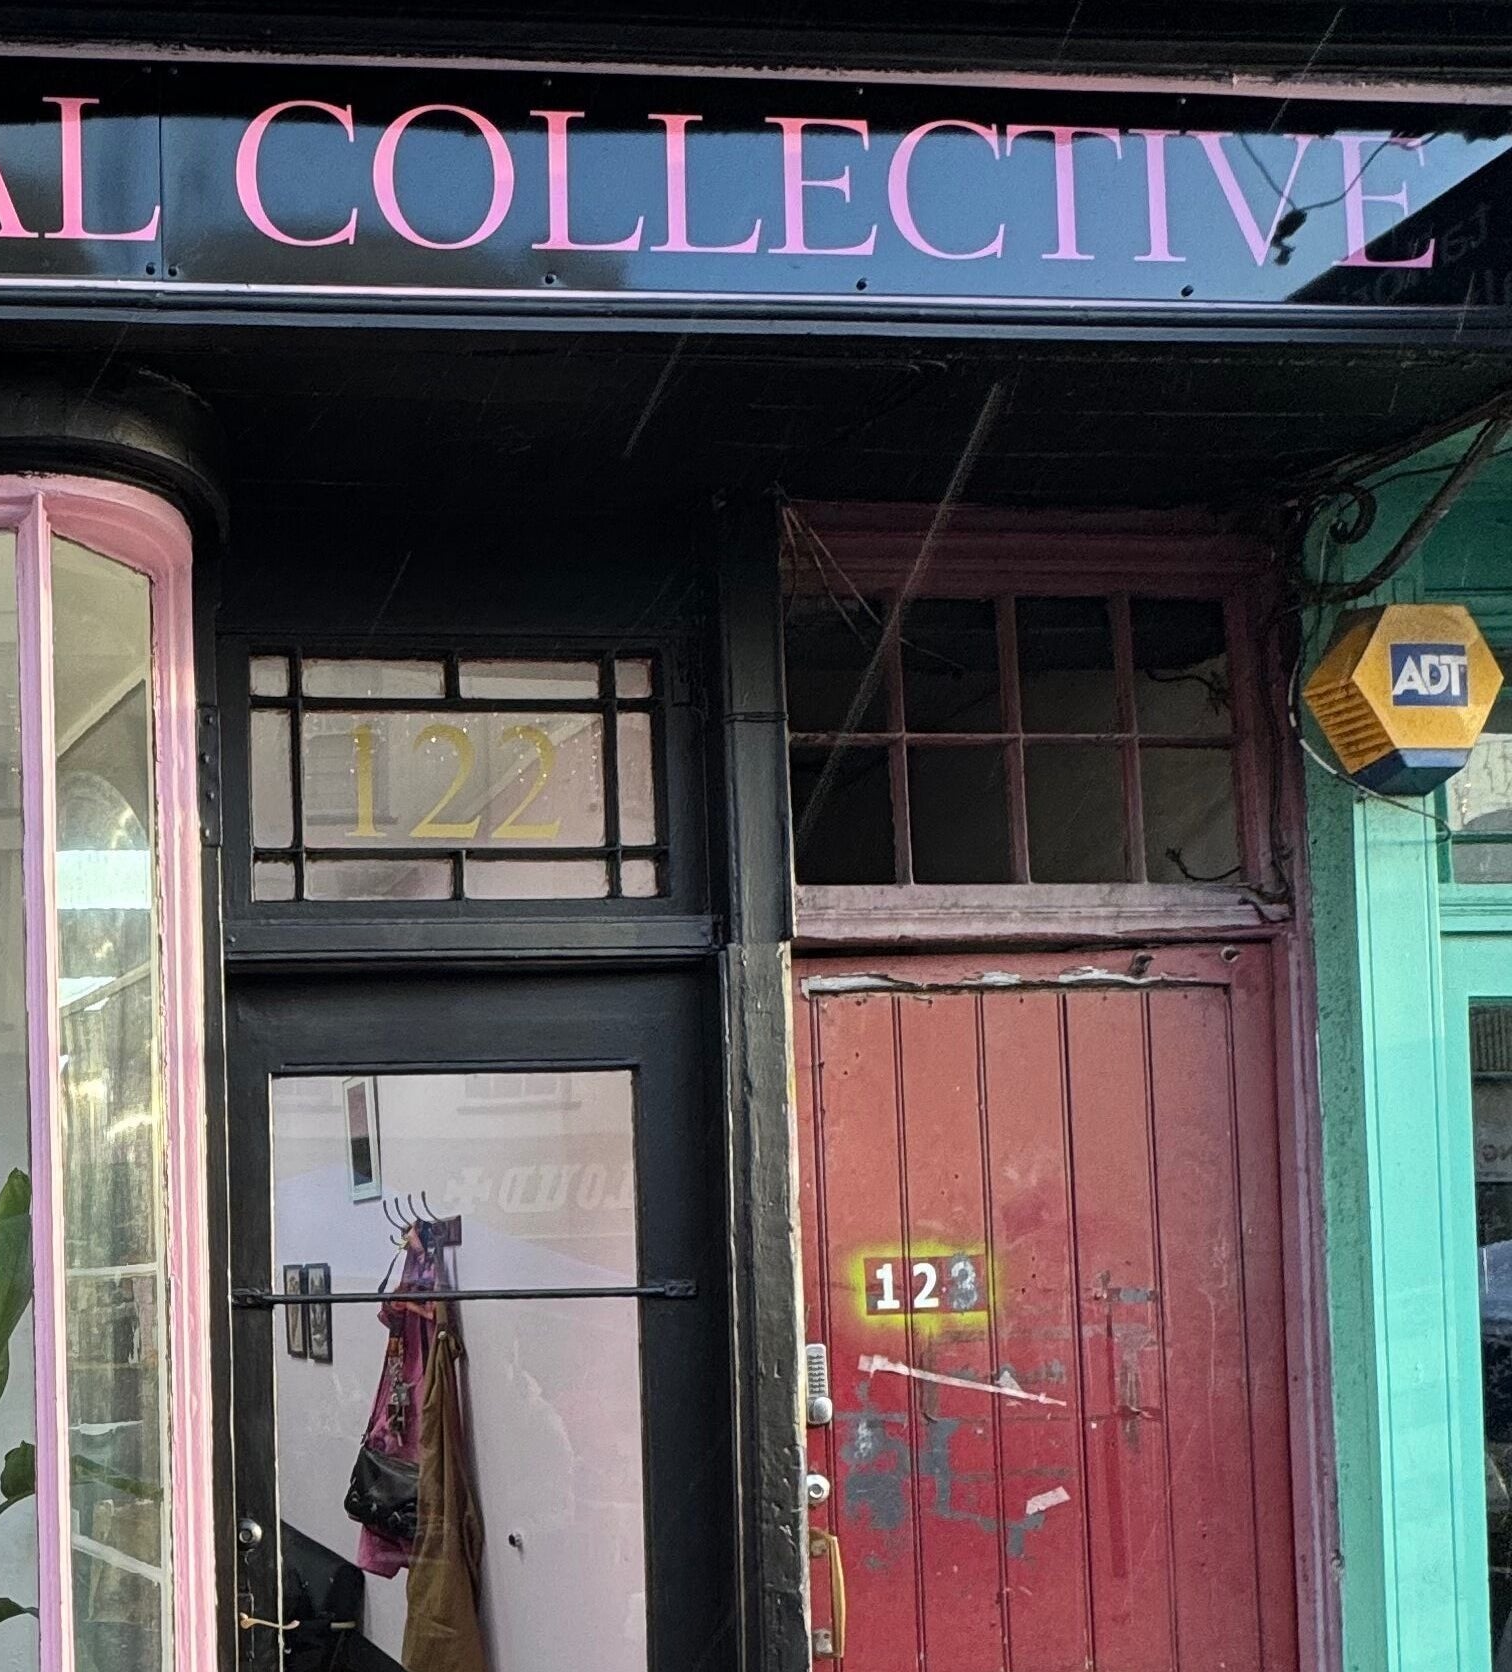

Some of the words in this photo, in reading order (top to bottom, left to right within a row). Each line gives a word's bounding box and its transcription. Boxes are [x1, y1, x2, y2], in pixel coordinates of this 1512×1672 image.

[236, 100, 1434, 269] COLLECTIVE
[1392, 654, 1468, 696] ADT
[344, 723, 562, 840] 122
[875, 1258, 979, 1312] 123
